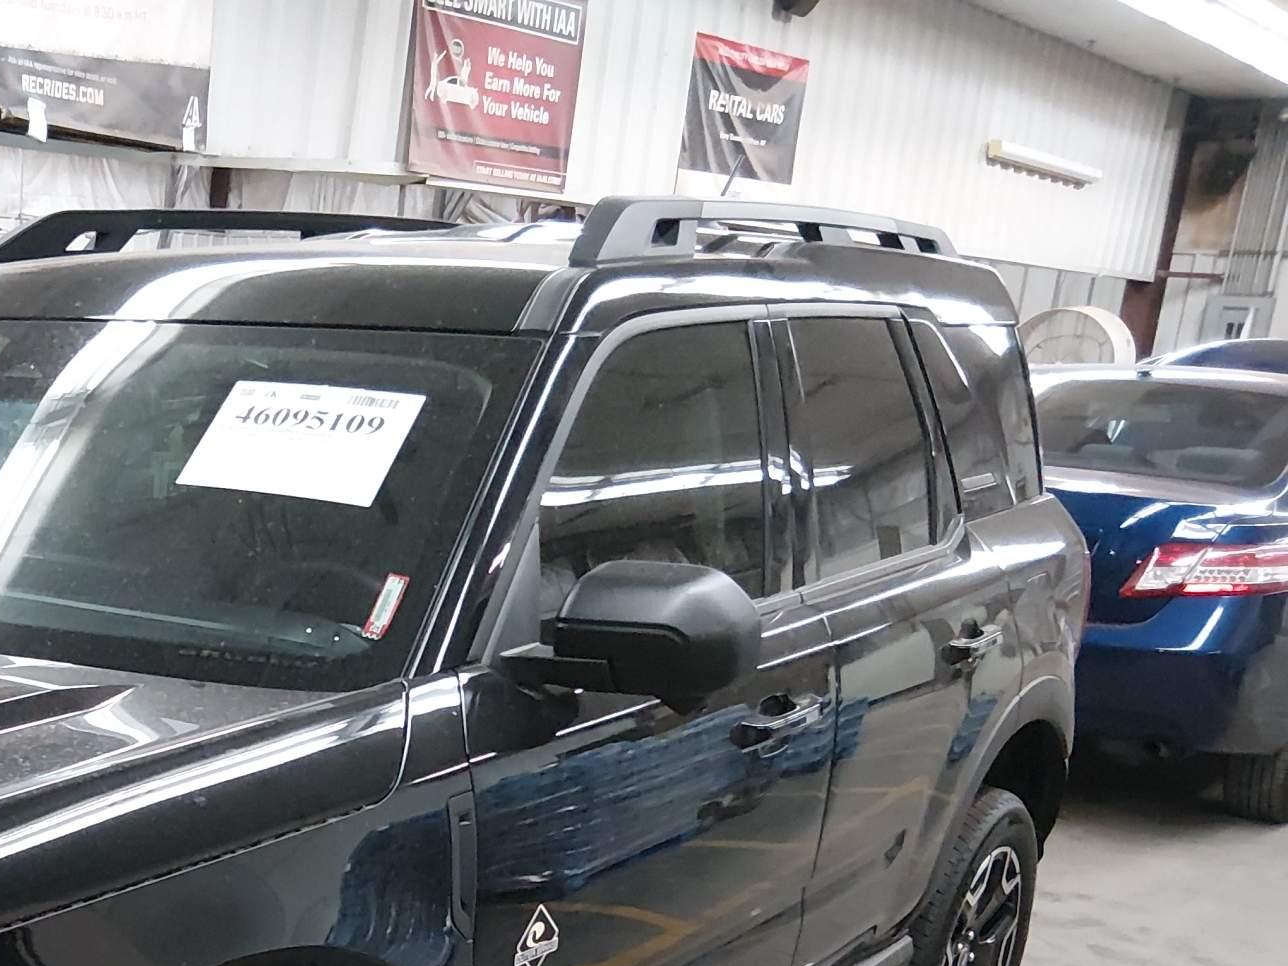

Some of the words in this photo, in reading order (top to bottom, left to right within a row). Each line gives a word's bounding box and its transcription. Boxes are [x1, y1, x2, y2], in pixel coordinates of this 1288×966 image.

[517, 0, 552, 31] WITH
[553, 7, 575, 37] IAA
[487, 46, 505, 67] We
[507, 51, 532, 77] Help
[535, 56, 554, 78] You
[21, 74, 104, 105] RECRIDES.COM
[484, 71, 510, 93] Earn
[512, 77, 541, 99] More
[543, 83, 561, 103] For
[482, 95, 508, 117] Your
[511, 100, 549, 125] Vehicle
[708, 89, 753, 119] RENTAL
[755, 102, 785, 124] CARS
[235, 405, 385, 434] 46095109
